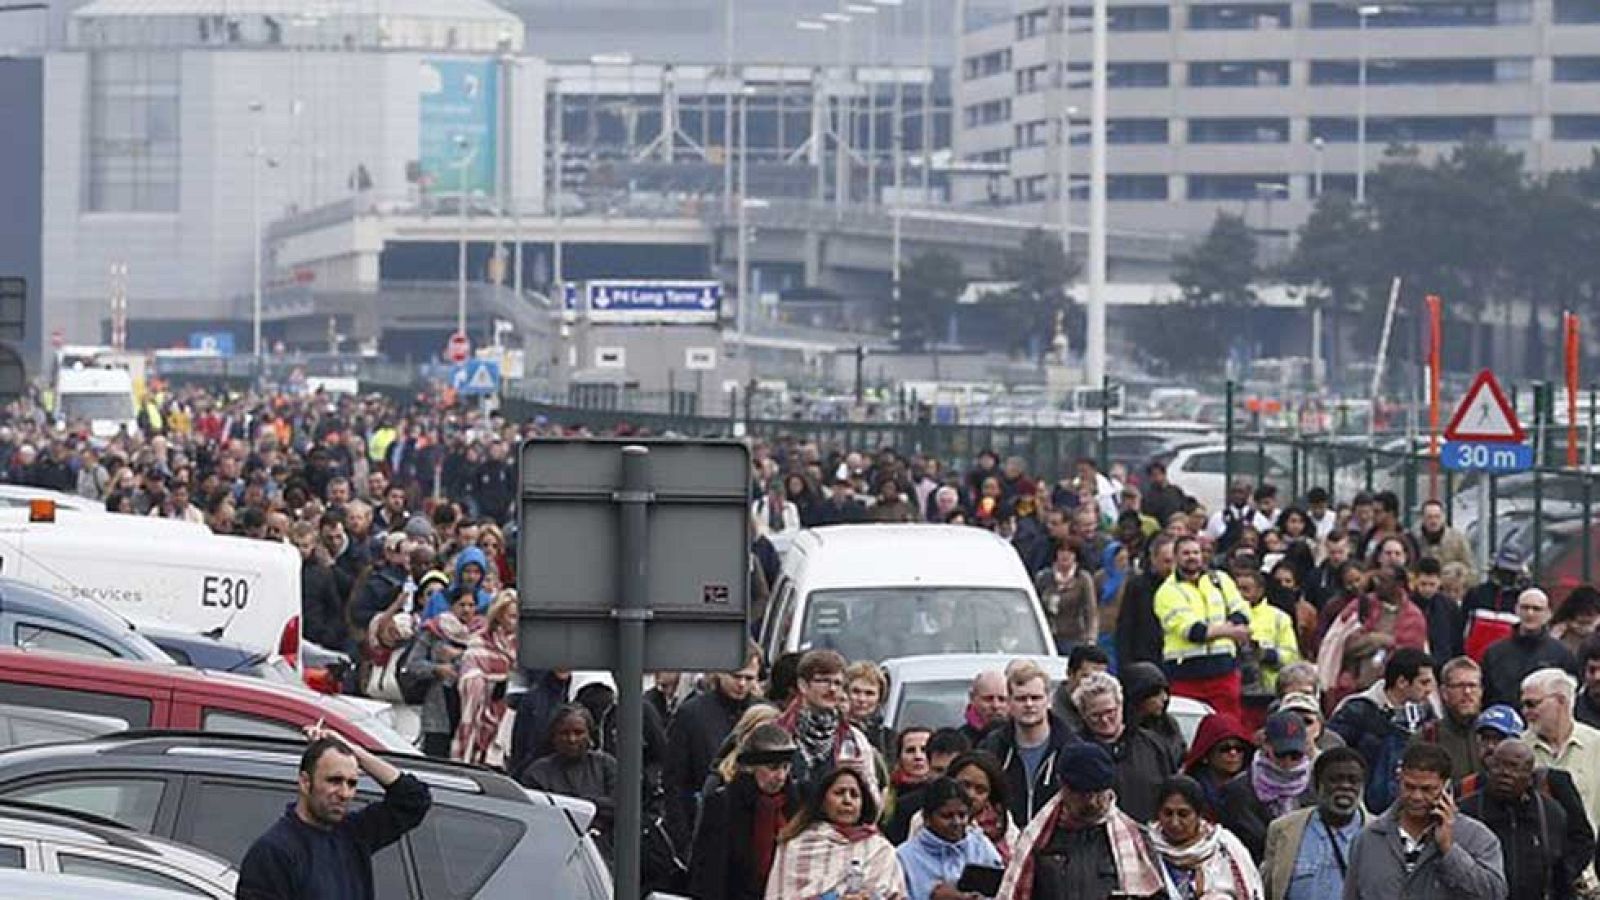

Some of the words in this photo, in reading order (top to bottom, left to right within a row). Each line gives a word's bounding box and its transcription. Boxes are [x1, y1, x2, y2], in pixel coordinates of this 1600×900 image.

[631, 290, 665, 306] Long
[1457, 444, 1489, 468] 30
[1493, 450, 1516, 468] m
[201, 575, 249, 610] E30
